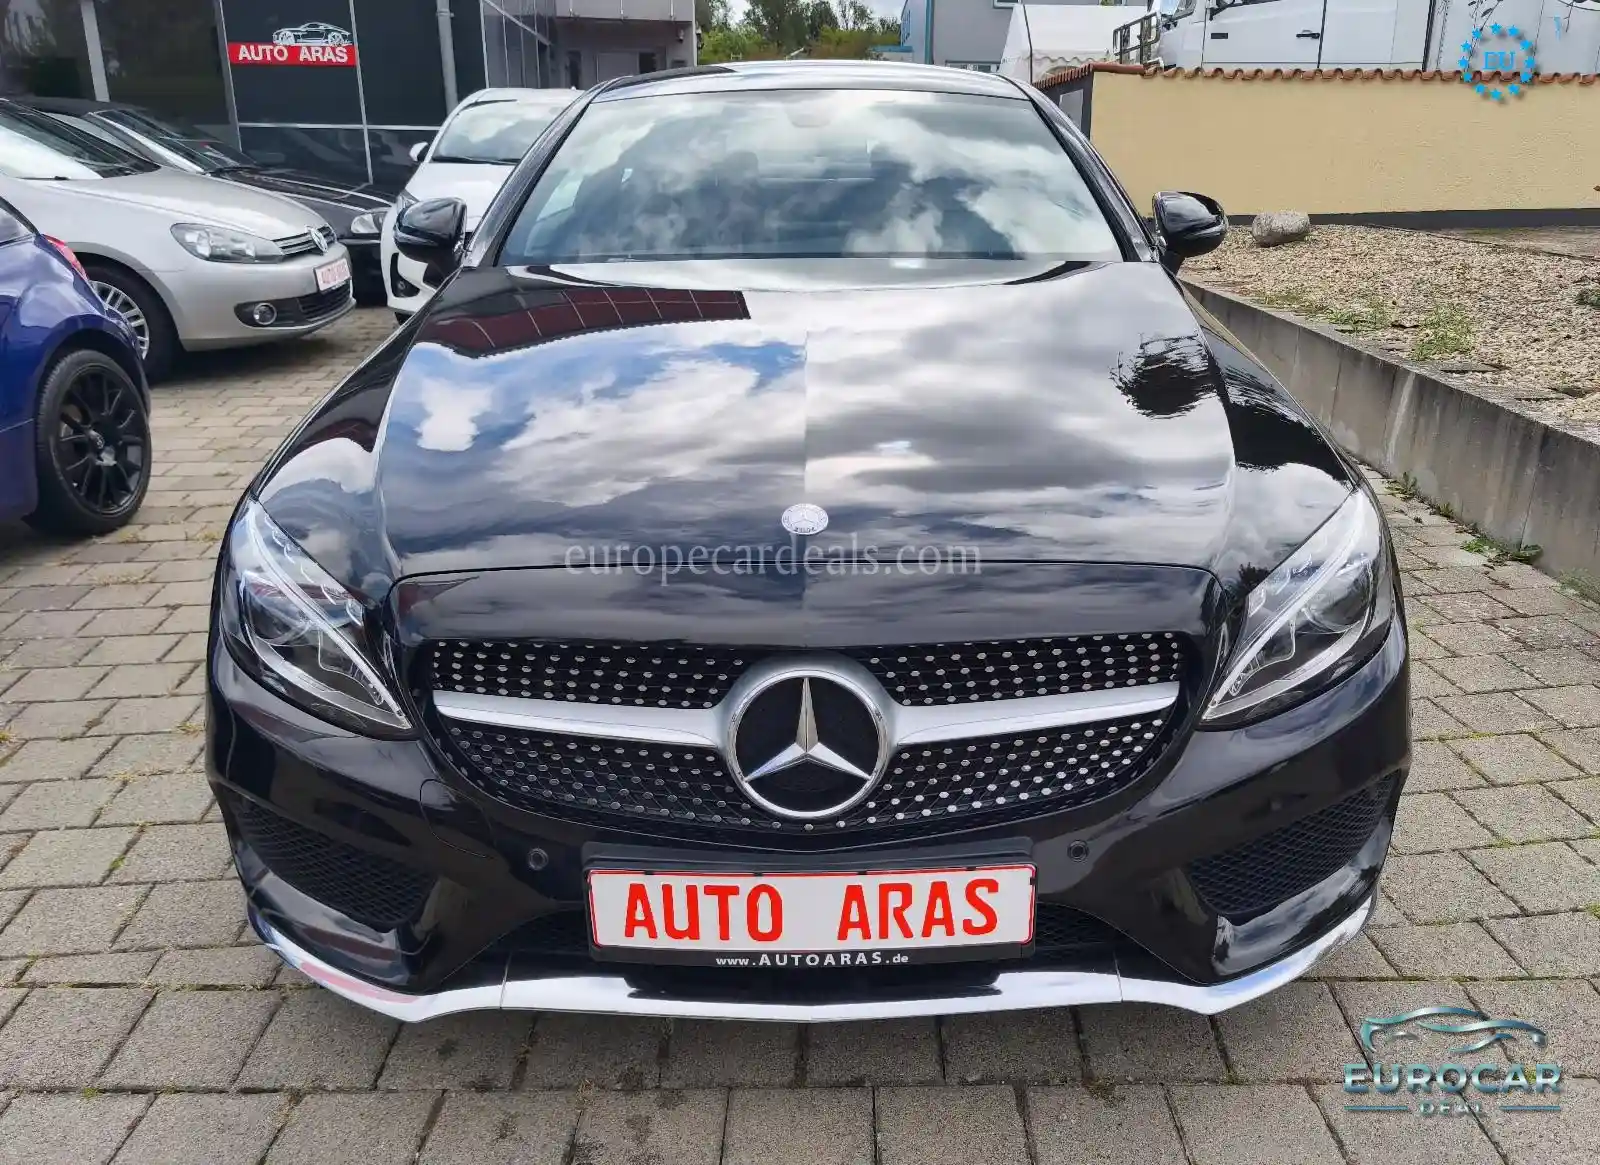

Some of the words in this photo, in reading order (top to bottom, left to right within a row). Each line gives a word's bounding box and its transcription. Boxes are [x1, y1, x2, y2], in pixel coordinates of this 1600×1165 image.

[239, 44, 288, 61] AUTO
[299, 45, 348, 63] ARAS
[624, 883, 783, 942] AUTO
[837, 878, 999, 941] ARAS
[715, 951, 909, 967] www.AUTOARAS.de
